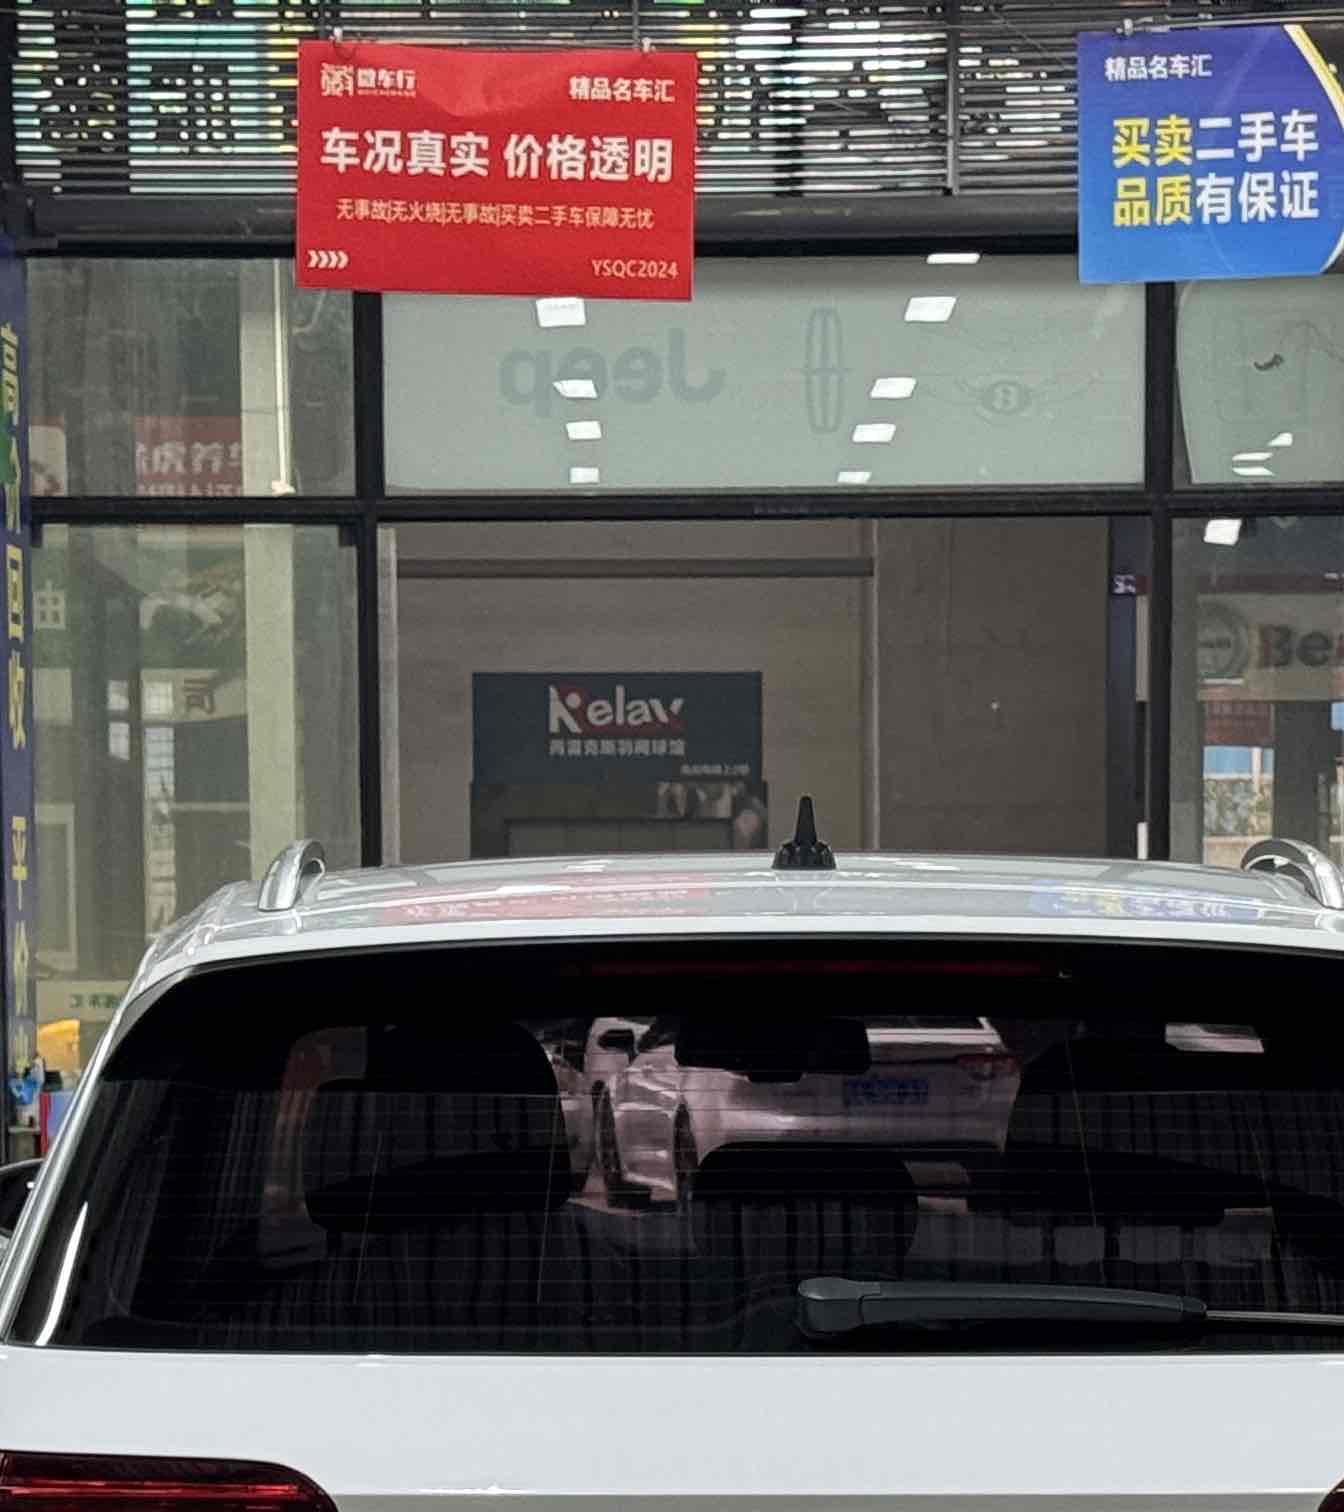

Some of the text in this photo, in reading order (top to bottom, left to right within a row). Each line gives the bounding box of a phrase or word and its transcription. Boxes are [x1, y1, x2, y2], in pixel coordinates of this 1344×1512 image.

[1104, 54, 1213, 81] 精品名车汇
[569, 75, 675, 103] 精品名车汇
[320, 126, 673, 183] 车况真实 价格透明
[1111, 109, 1319, 168] 买卖二手车
[1112, 170, 1320, 227] 品质有保证
[592, 259, 679, 279] YSQC2024
